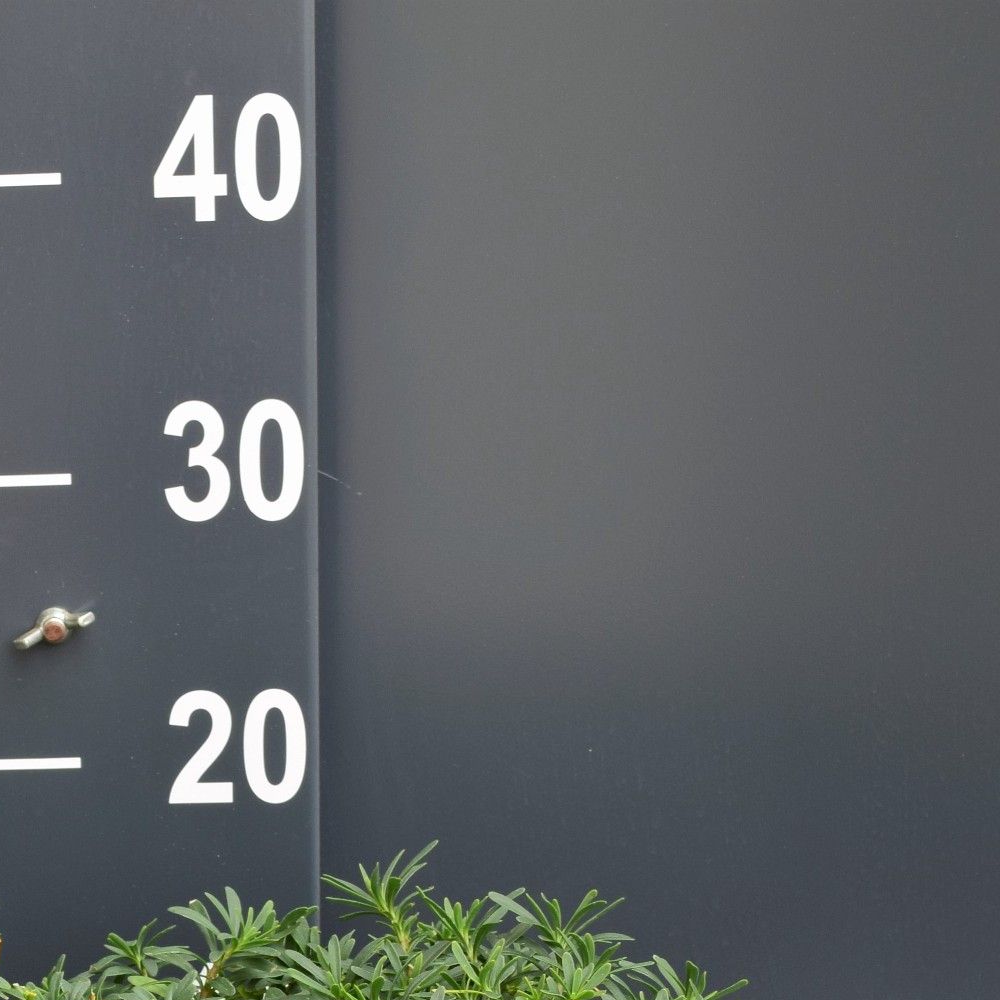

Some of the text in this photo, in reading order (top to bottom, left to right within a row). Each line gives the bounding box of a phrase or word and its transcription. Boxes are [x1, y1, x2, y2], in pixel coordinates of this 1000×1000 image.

[154, 93, 303, 222] 40
[164, 399, 305, 522] 30
[169, 689, 307, 804] 20
